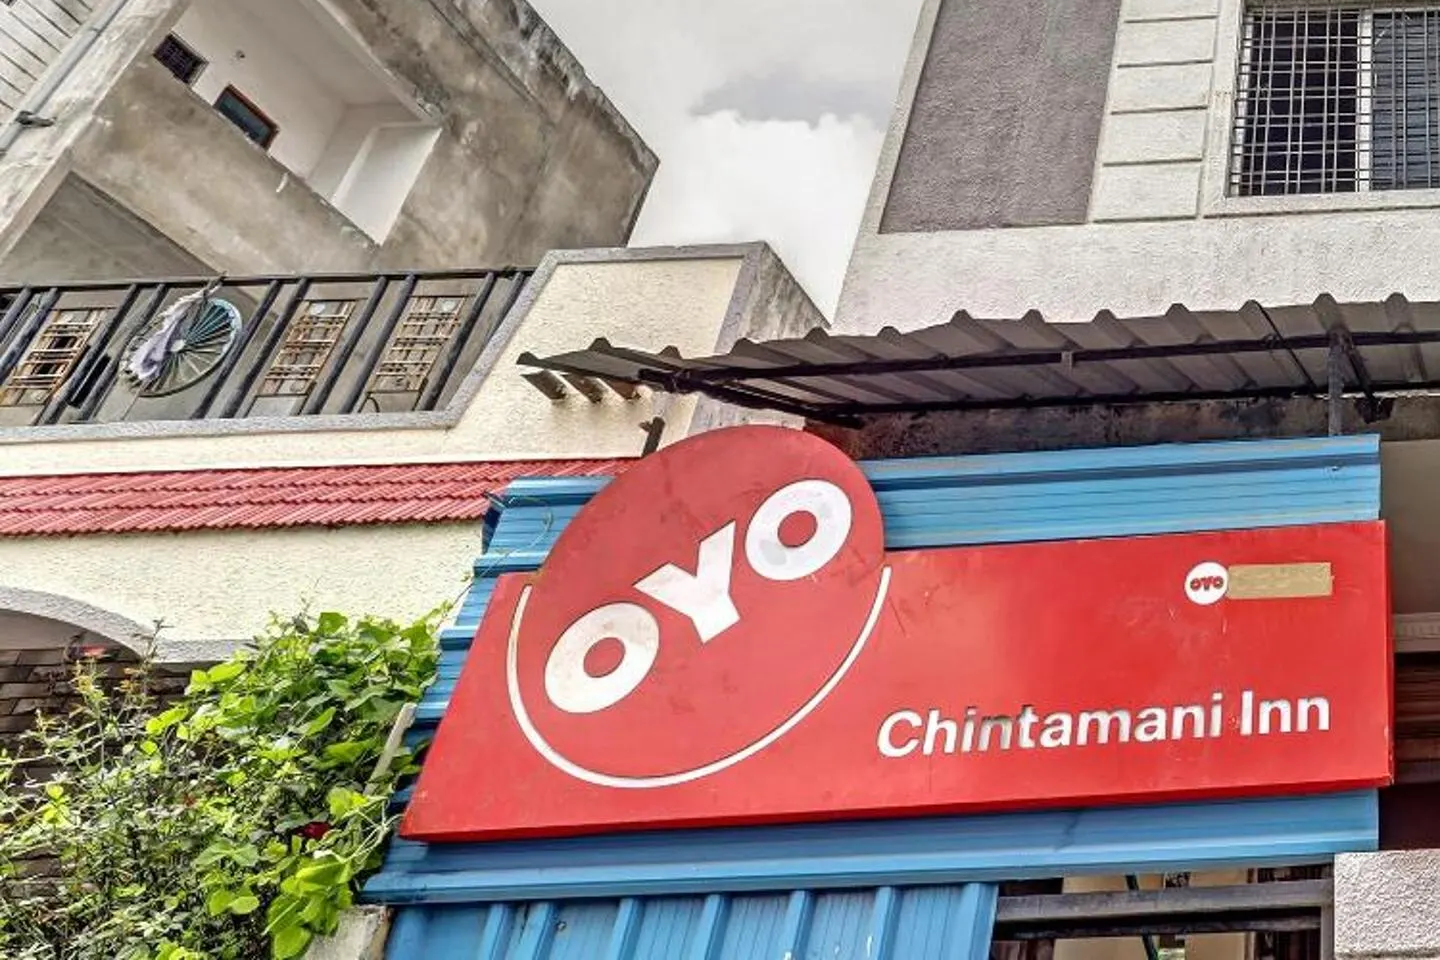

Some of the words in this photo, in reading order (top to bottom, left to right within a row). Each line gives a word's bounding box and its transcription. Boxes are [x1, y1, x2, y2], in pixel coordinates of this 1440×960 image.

[544, 479, 852, 713] OYO
[1190, 575, 1225, 592] OYO
[877, 691, 1223, 758] Chintamani
[1240, 689, 1331, 737] Inn
